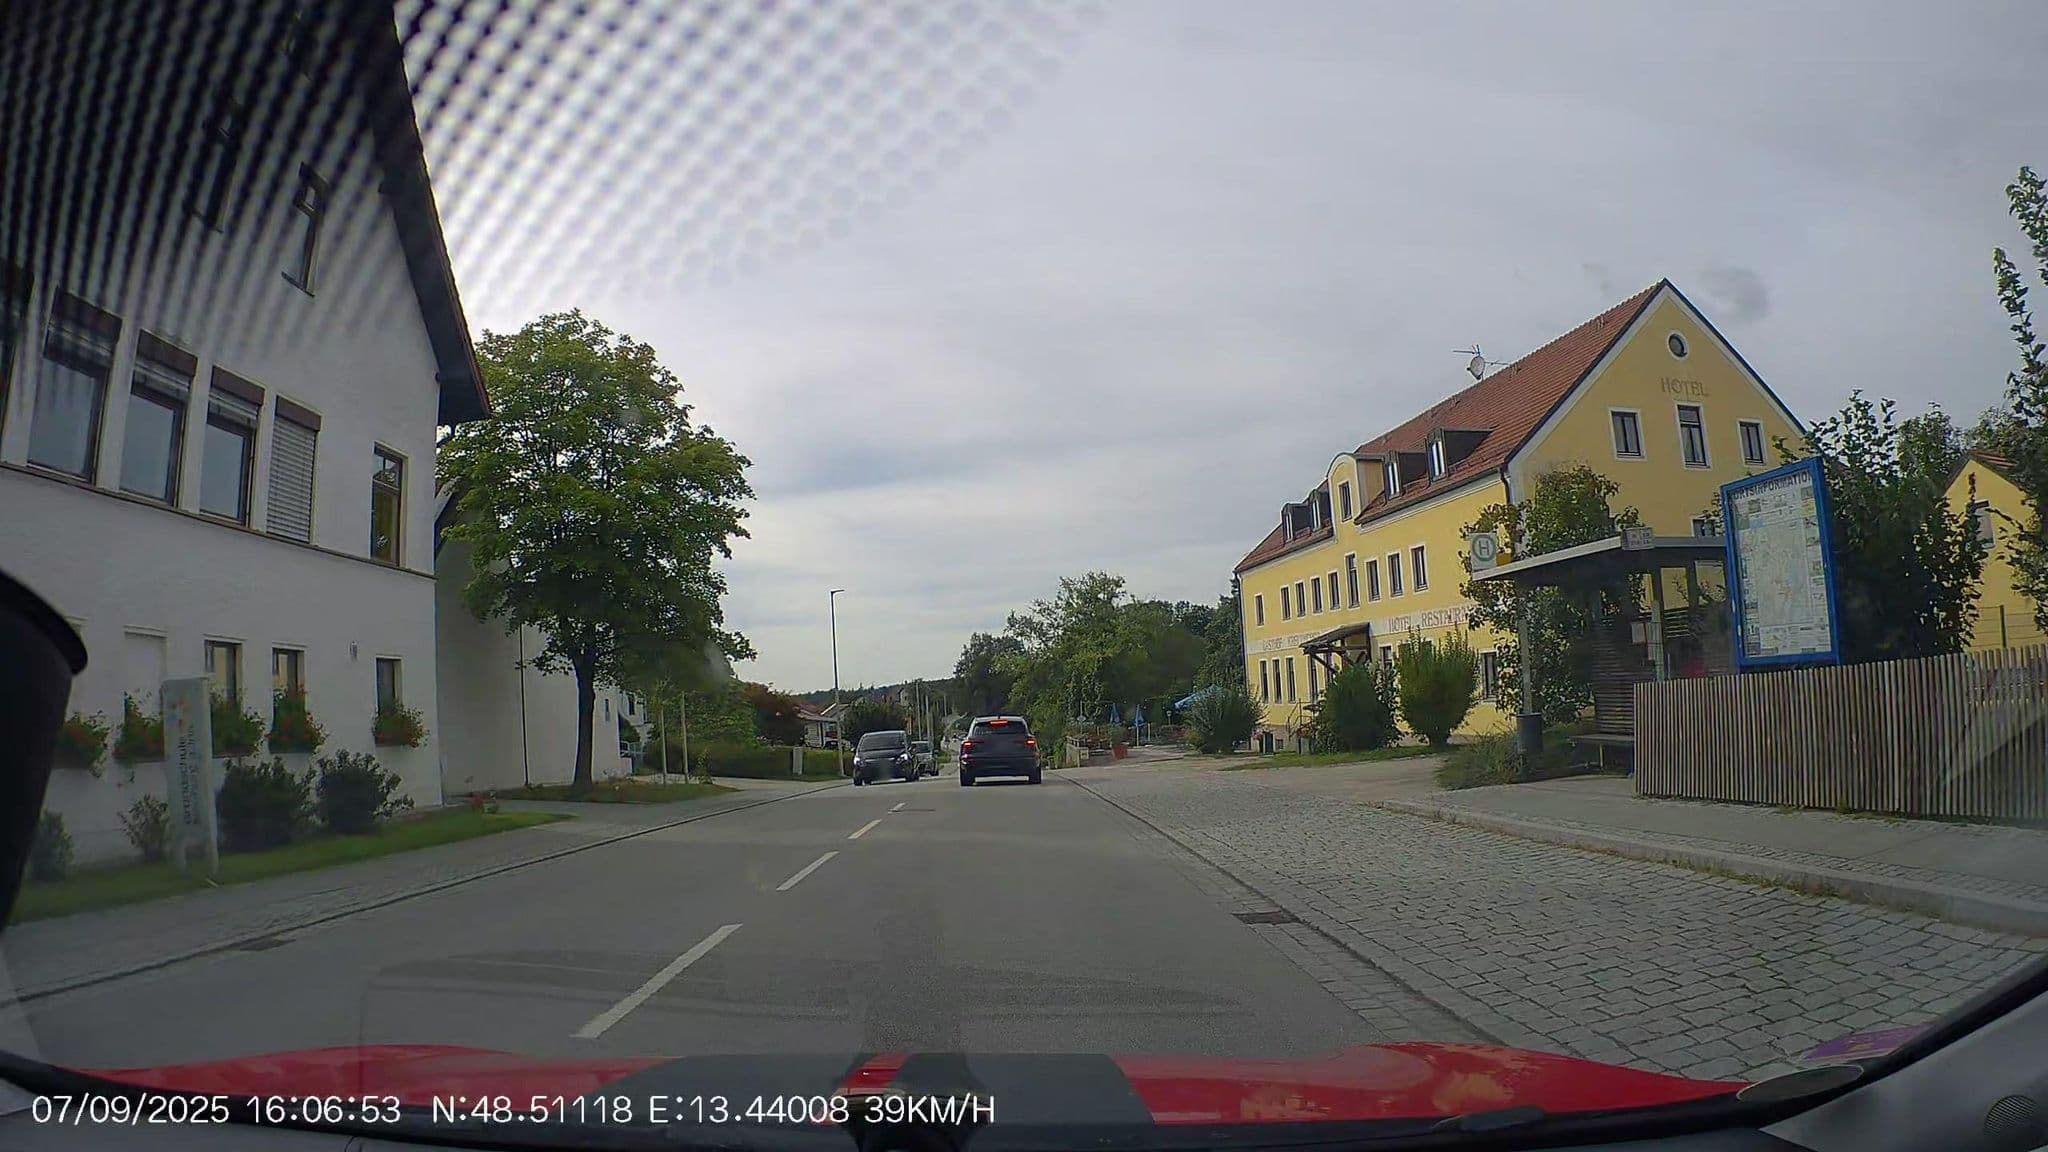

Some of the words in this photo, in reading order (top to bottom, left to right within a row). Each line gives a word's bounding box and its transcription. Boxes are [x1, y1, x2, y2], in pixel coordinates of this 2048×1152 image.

[1660, 377, 1709, 397] HOTEL
[1478, 540, 1490, 556] H
[1388, 615, 1412, 633] HOTEL
[1421, 603, 1480, 628] RESTAURA
